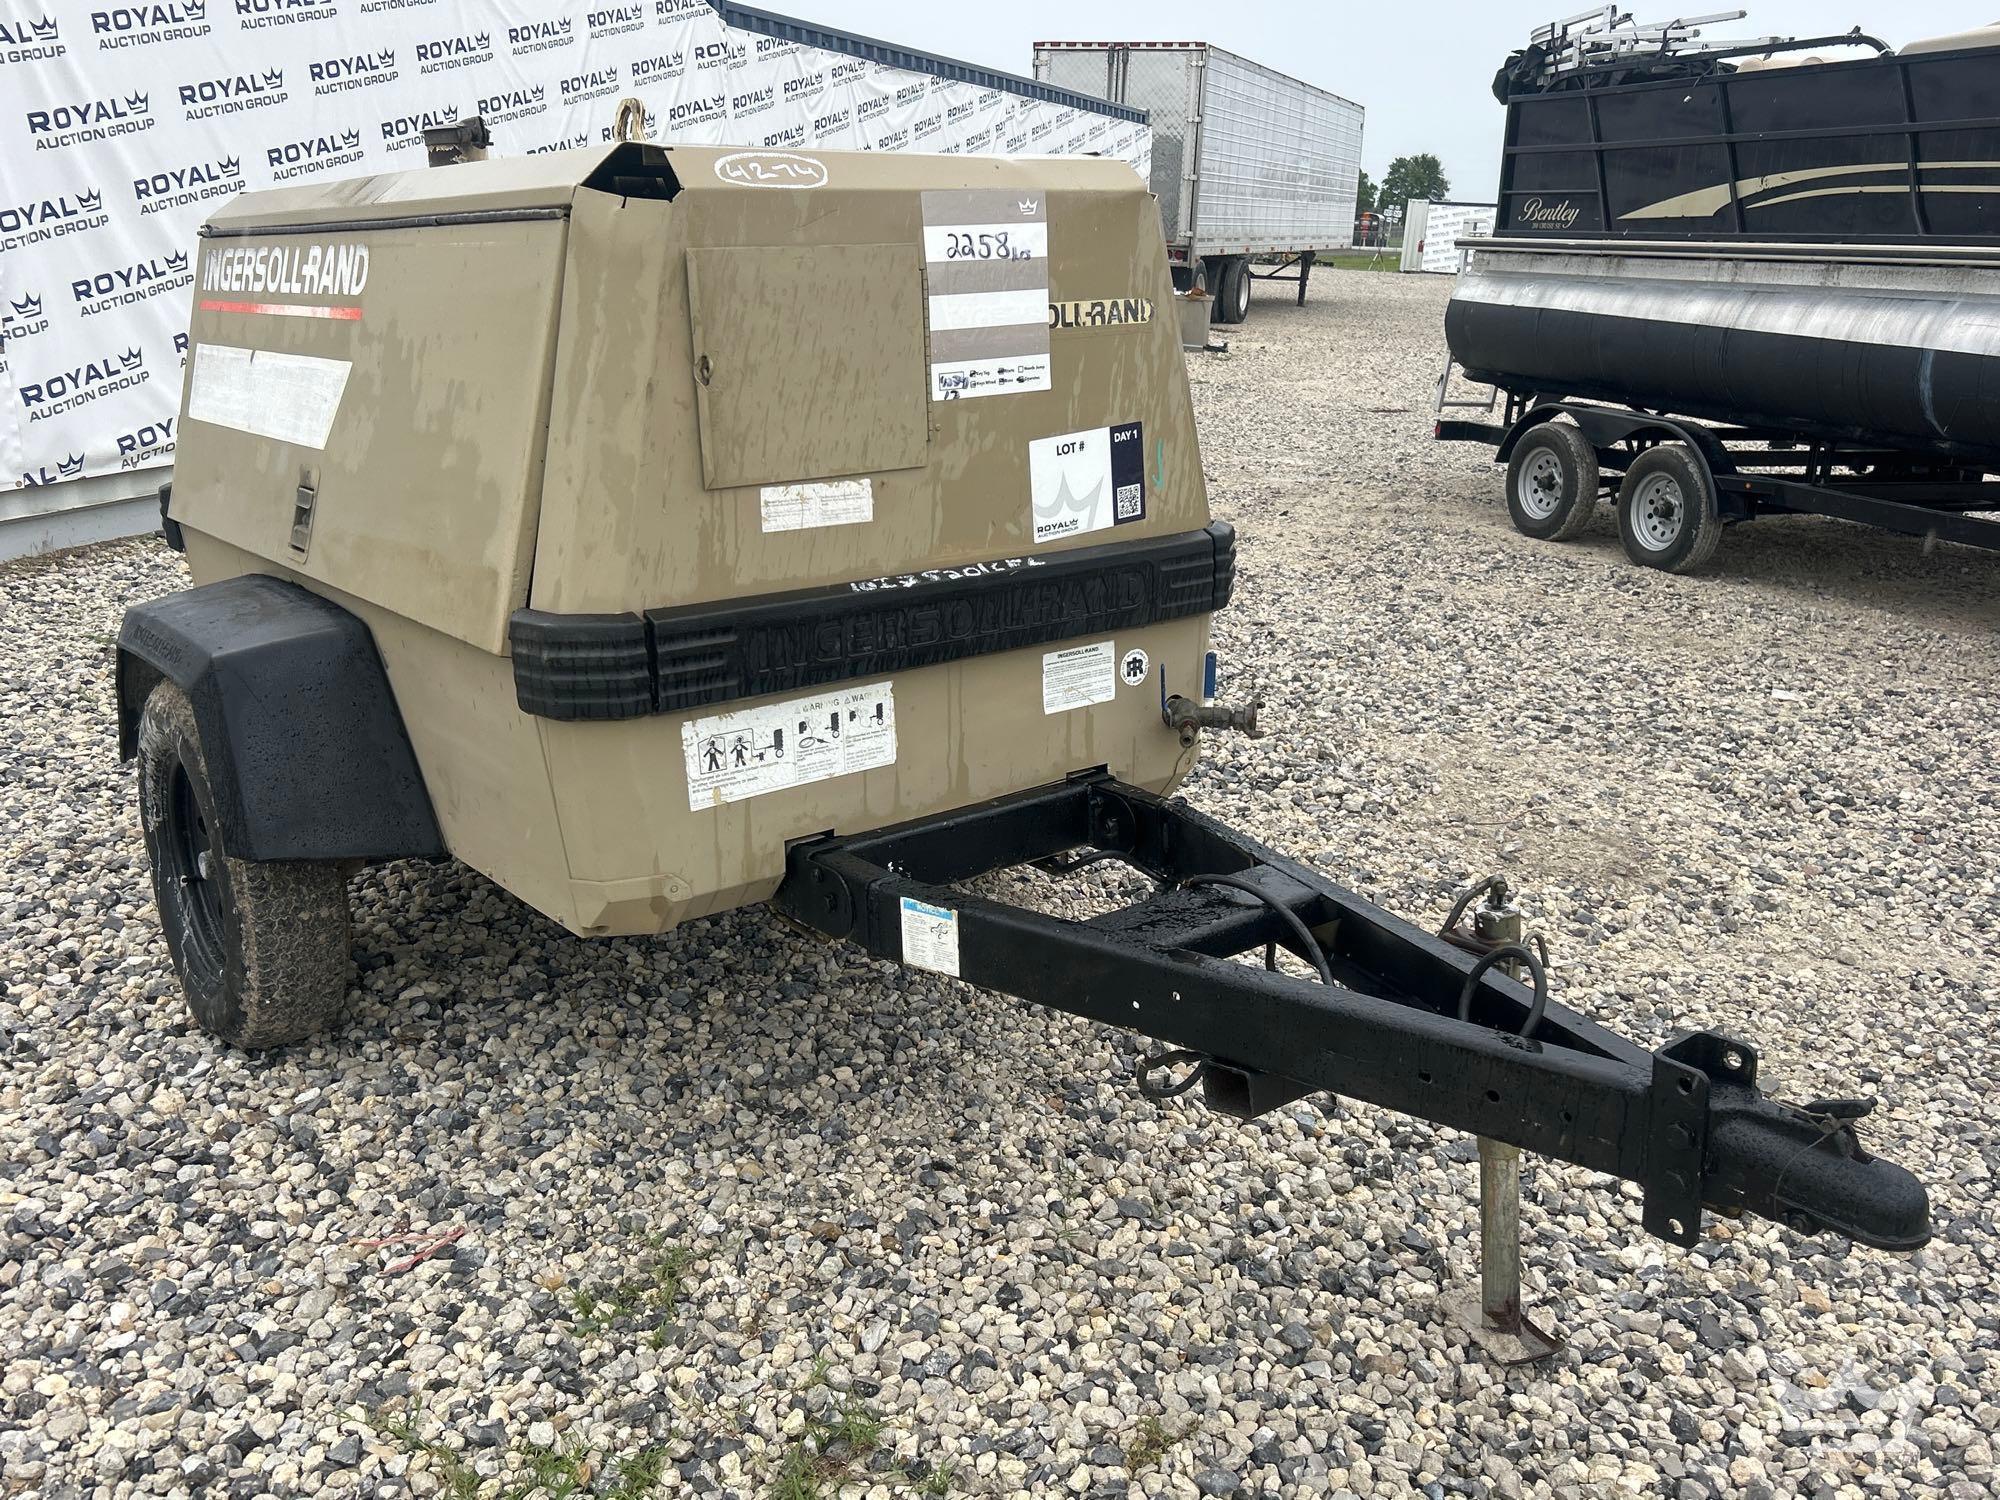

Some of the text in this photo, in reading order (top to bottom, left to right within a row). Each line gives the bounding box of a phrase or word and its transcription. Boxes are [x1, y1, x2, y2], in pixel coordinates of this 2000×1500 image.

[91, 4, 184, 34] ROYAL
[240, 8, 337, 30] AUCTION GROUP
[360, 0, 405, 13] AUCTION
[587, 8, 632, 28] ROYAL
[100, 25, 211, 50] AUCTION GROUP
[508, 21, 560, 44] ROYAL
[590, 22, 645, 39] AUCTION GROUP
[8, 45, 66, 63] GROUP
[416, 36, 476, 61] ROYAL
[512, 36, 574, 56] AUCTION GROUP
[309, 54, 379, 81] ROYAL
[420, 52, 494, 74] AUCTION GROUP
[632, 55, 673, 76] ROYAL
[178, 74, 264, 105] ROYAL
[315, 71, 398, 96] AUCTION GROUP
[561, 70, 606, 95] ROYAL
[563, 84, 619, 106] AUCTION GROUP
[783, 75, 815, 94] ROYAL
[186, 93, 288, 121] AUCTION GROUP
[478, 90, 532, 115] ROYAL
[520, 104, 547, 118] GROUP
[670, 98, 713, 121] ROYAL
[733, 90, 765, 110] ROYAL
[27, 99, 127, 133] ROYAL
[381, 111, 443, 139] ROYAL
[814, 112, 842, 131] ROYAL
[36, 118, 155, 150] AUCTION GROUP
[267, 135, 343, 167] ROYAL
[273, 151, 364, 181] AUCTION GROUP
[133, 163, 220, 200] ROYAL
[140, 180, 246, 216] AUCTION GROUP
[1518, 197, 1580, 228] Bentley
[53, 215, 109, 237] GROUP
[72, 259, 166, 302] ROYAL
[80, 274, 194, 318] AUCTION GROUP
[19, 358, 121, 407] ROYAL
[30, 370, 150, 423] AUCTION GROUP
[1114, 429, 1138, 442] DAY 1
[1056, 441, 1085, 456] LOT #
[1037, 520, 1069, 533] ROYAL
